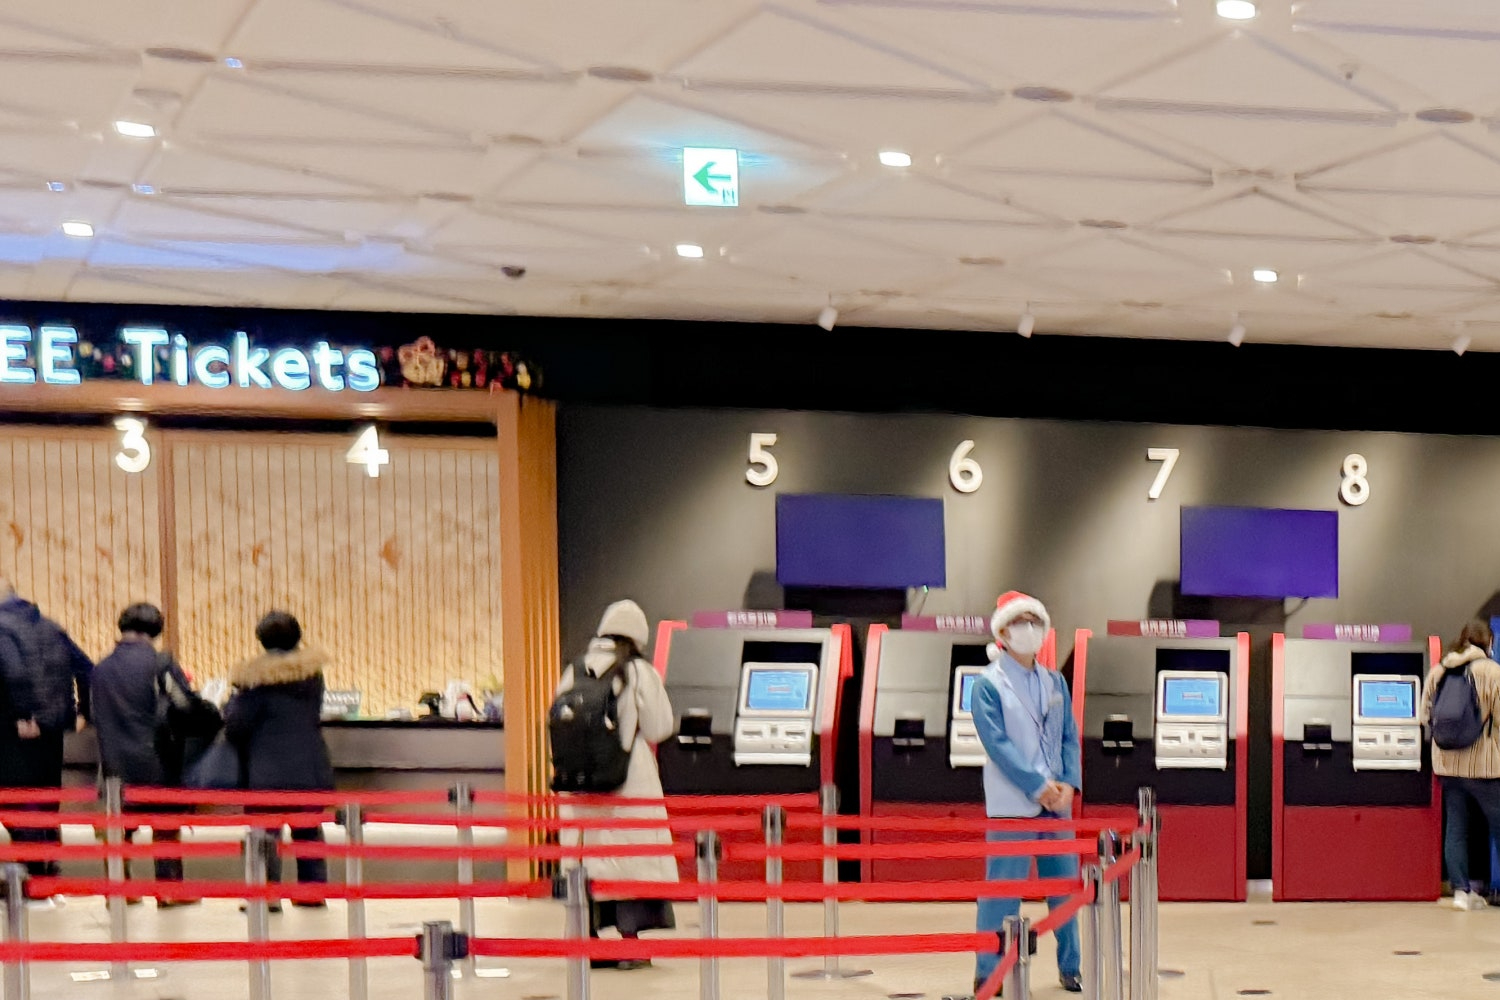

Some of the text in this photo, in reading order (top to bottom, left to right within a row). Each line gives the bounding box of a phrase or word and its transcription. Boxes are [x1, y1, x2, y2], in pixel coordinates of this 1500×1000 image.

[123, 327, 380, 392] Tickets
[114, 417, 151, 473] 3
[346, 425, 390, 478] 4
[745, 432, 779, 487] 5
[949, 439, 983, 494] 6
[1146, 447, 1180, 499] 7
[1339, 453, 1370, 506] 8
